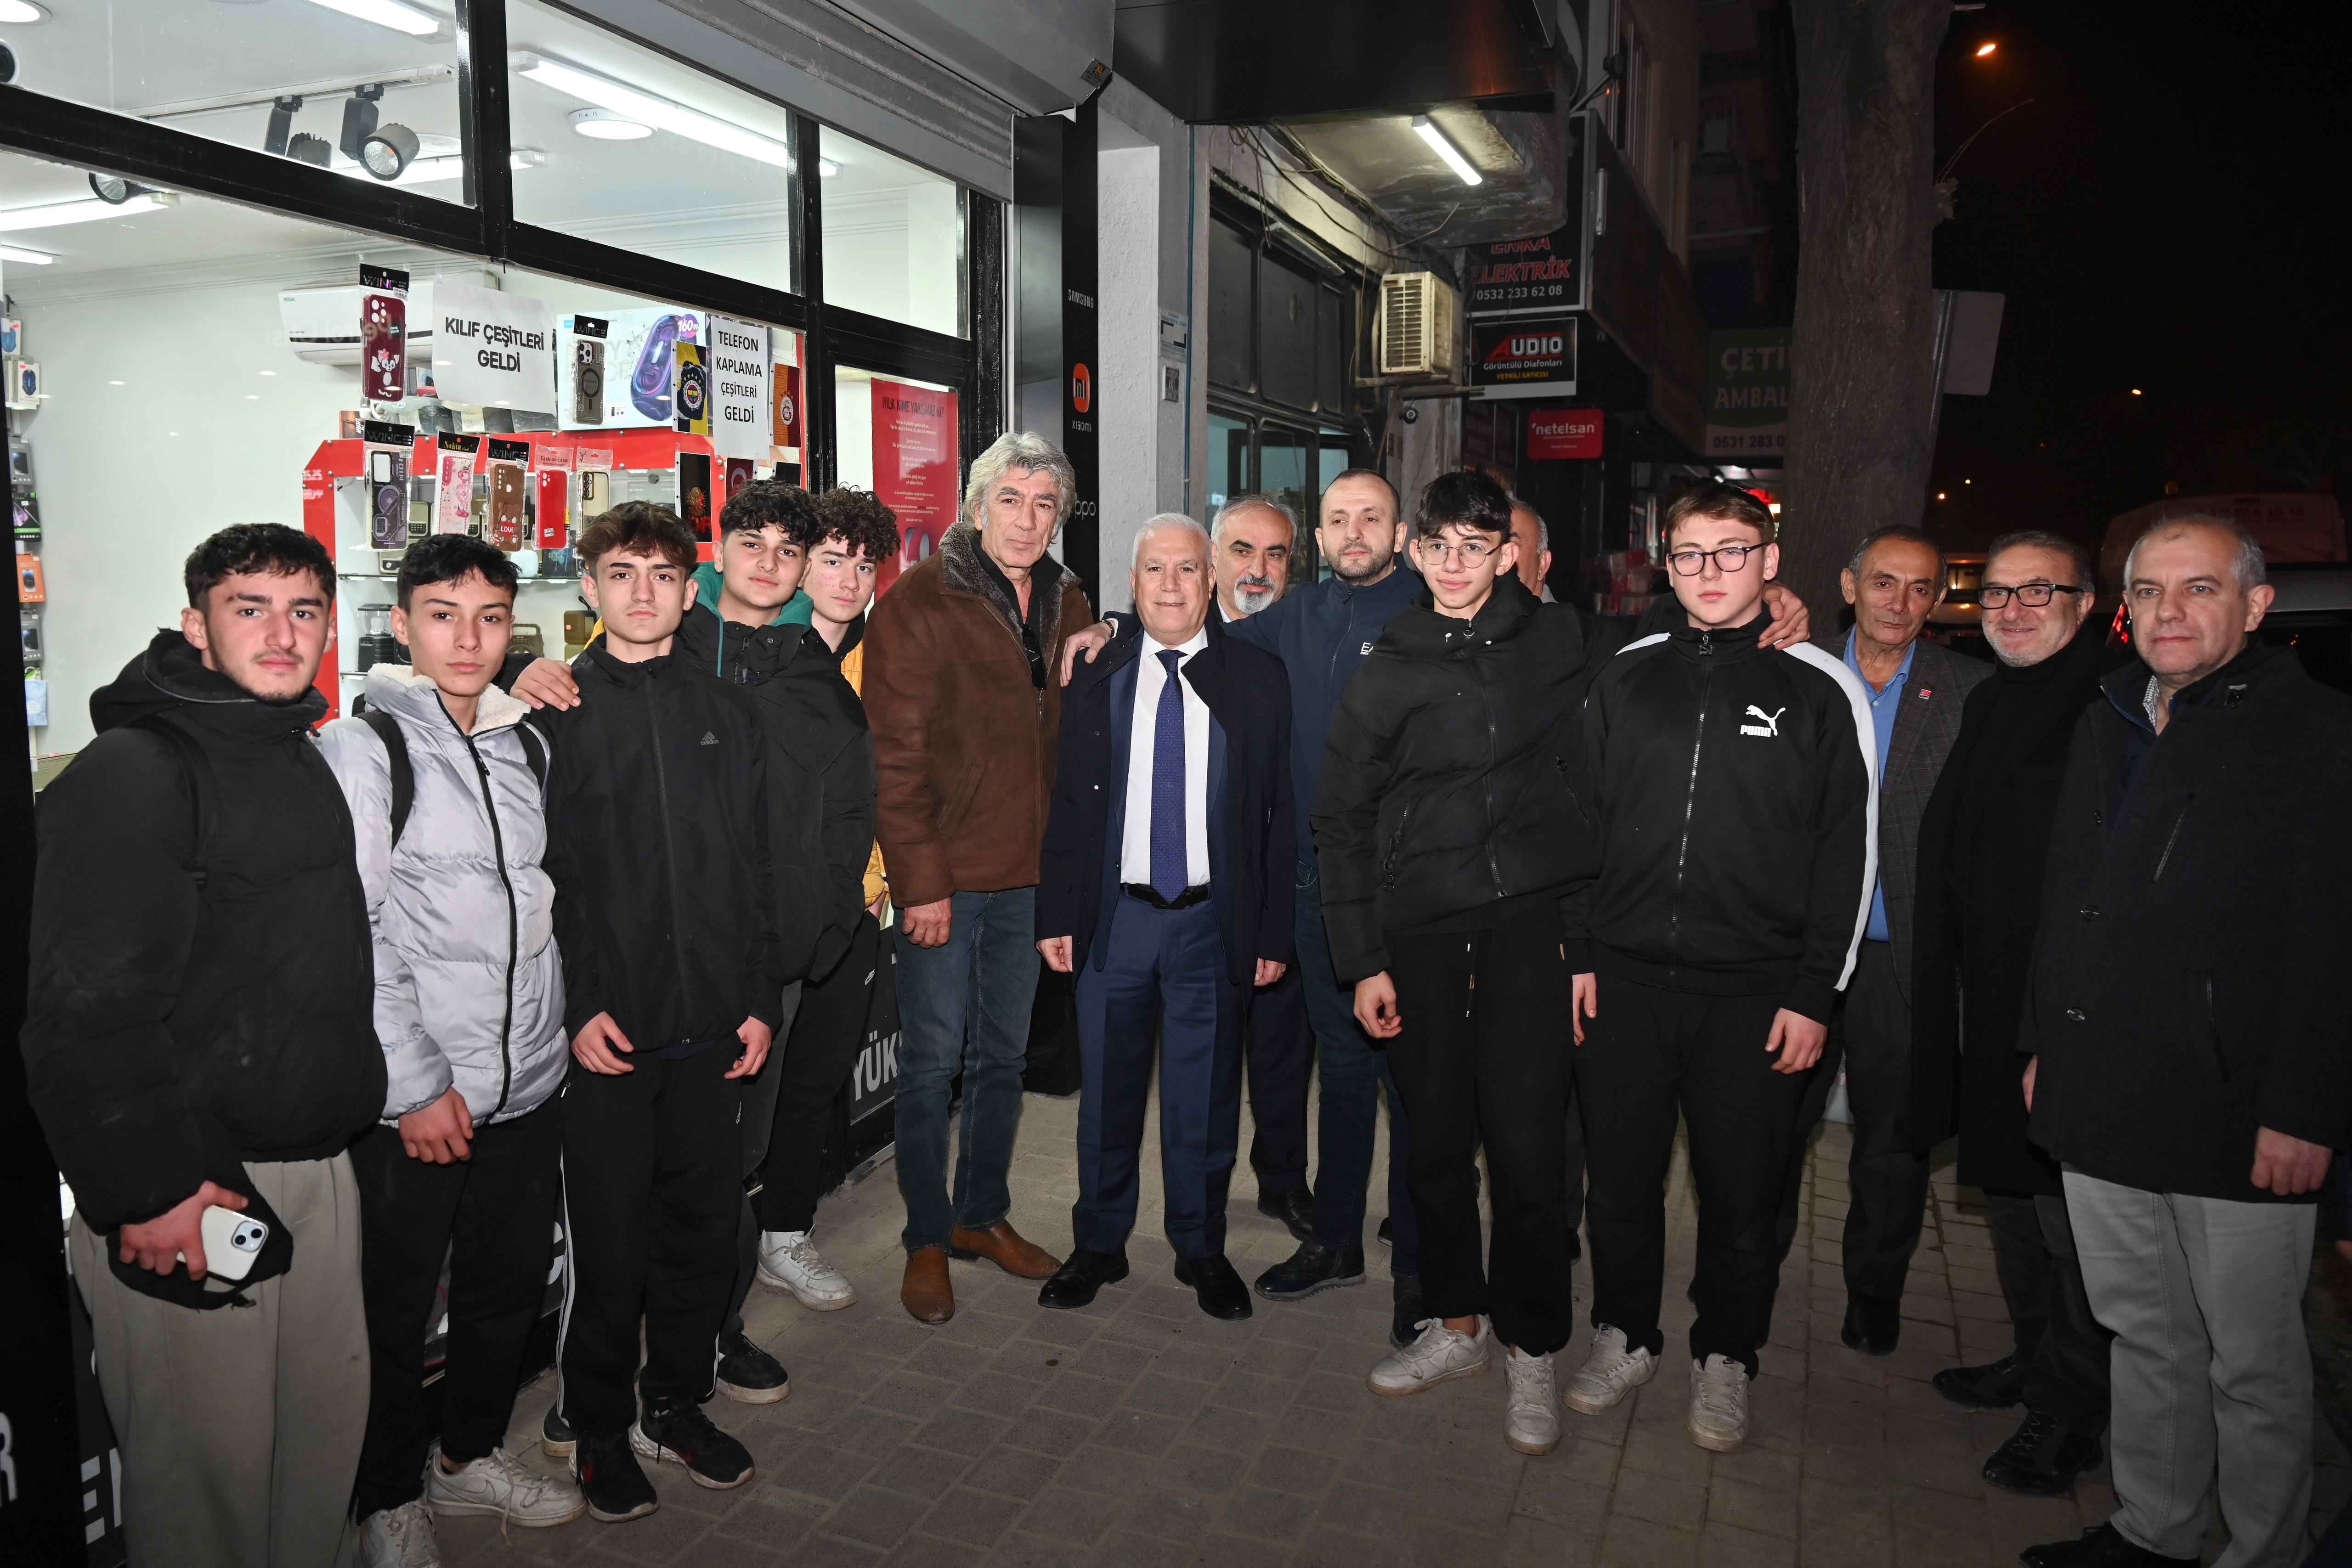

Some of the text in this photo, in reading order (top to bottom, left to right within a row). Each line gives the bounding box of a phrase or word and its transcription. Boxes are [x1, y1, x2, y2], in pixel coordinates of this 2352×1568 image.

[1068, 289, 1094, 309] SAMSUNG
[1477, 285, 1562, 300] 0532 233 62 08
[446, 317, 480, 338] KILIF
[484, 324, 544, 350] ÇEŞİTLERİ
[718, 331, 758, 351] TELEFON
[1485, 333, 1563, 362] AUDIO
[478, 350, 520, 372] GELDİ
[716, 356, 762, 377] KAPLAMA
[1483, 359, 1562, 370] Görüntülü Diafonları
[721, 382, 757, 398] ÇEŞİTLERİ
[725, 406, 754, 423] GELDİ
[882, 396, 895, 410] İYİLİK
[897, 399, 910, 412] KİME
[911, 401, 935, 417] YAKIŞMAZ
[1072, 420, 1091, 433] xiaomi
[367, 430, 412, 445] WINCE
[444, 441, 461, 450] Nokta
[1713, 435, 1744, 448] 0531
[1749, 435, 1772, 448] 283
[1074, 500, 1096, 520] ppo
[1740, 725, 1771, 737] PUMA
[853, 1030, 903, 1101] YÜK
